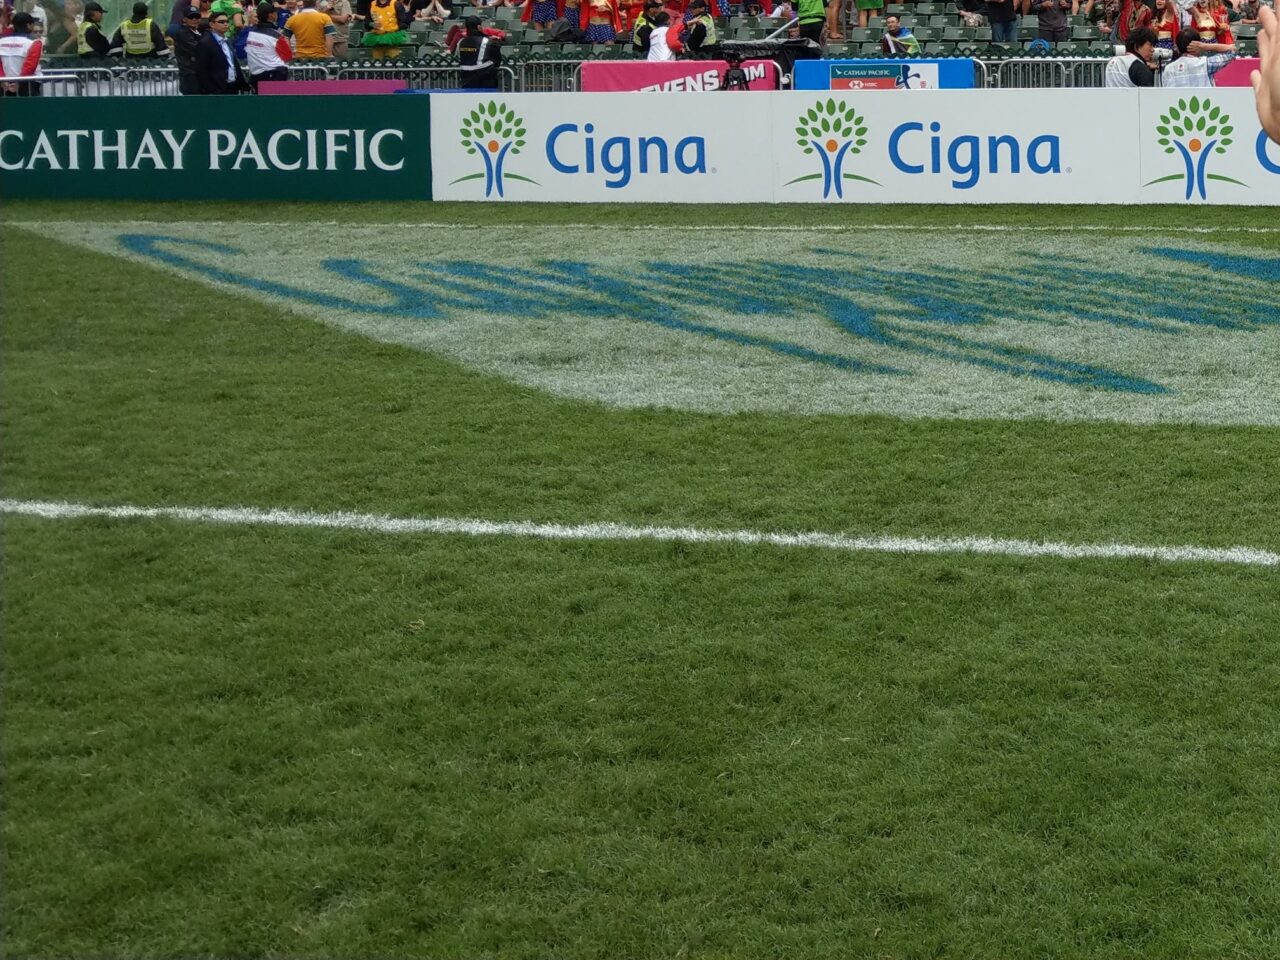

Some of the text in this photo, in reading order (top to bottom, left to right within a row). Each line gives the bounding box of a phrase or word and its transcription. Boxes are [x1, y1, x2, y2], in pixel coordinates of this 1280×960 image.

[0, 128, 406, 171] CATHAY PACIFIC
[546, 123, 706, 189] Cigna
[888, 122, 1060, 189] Cigna
